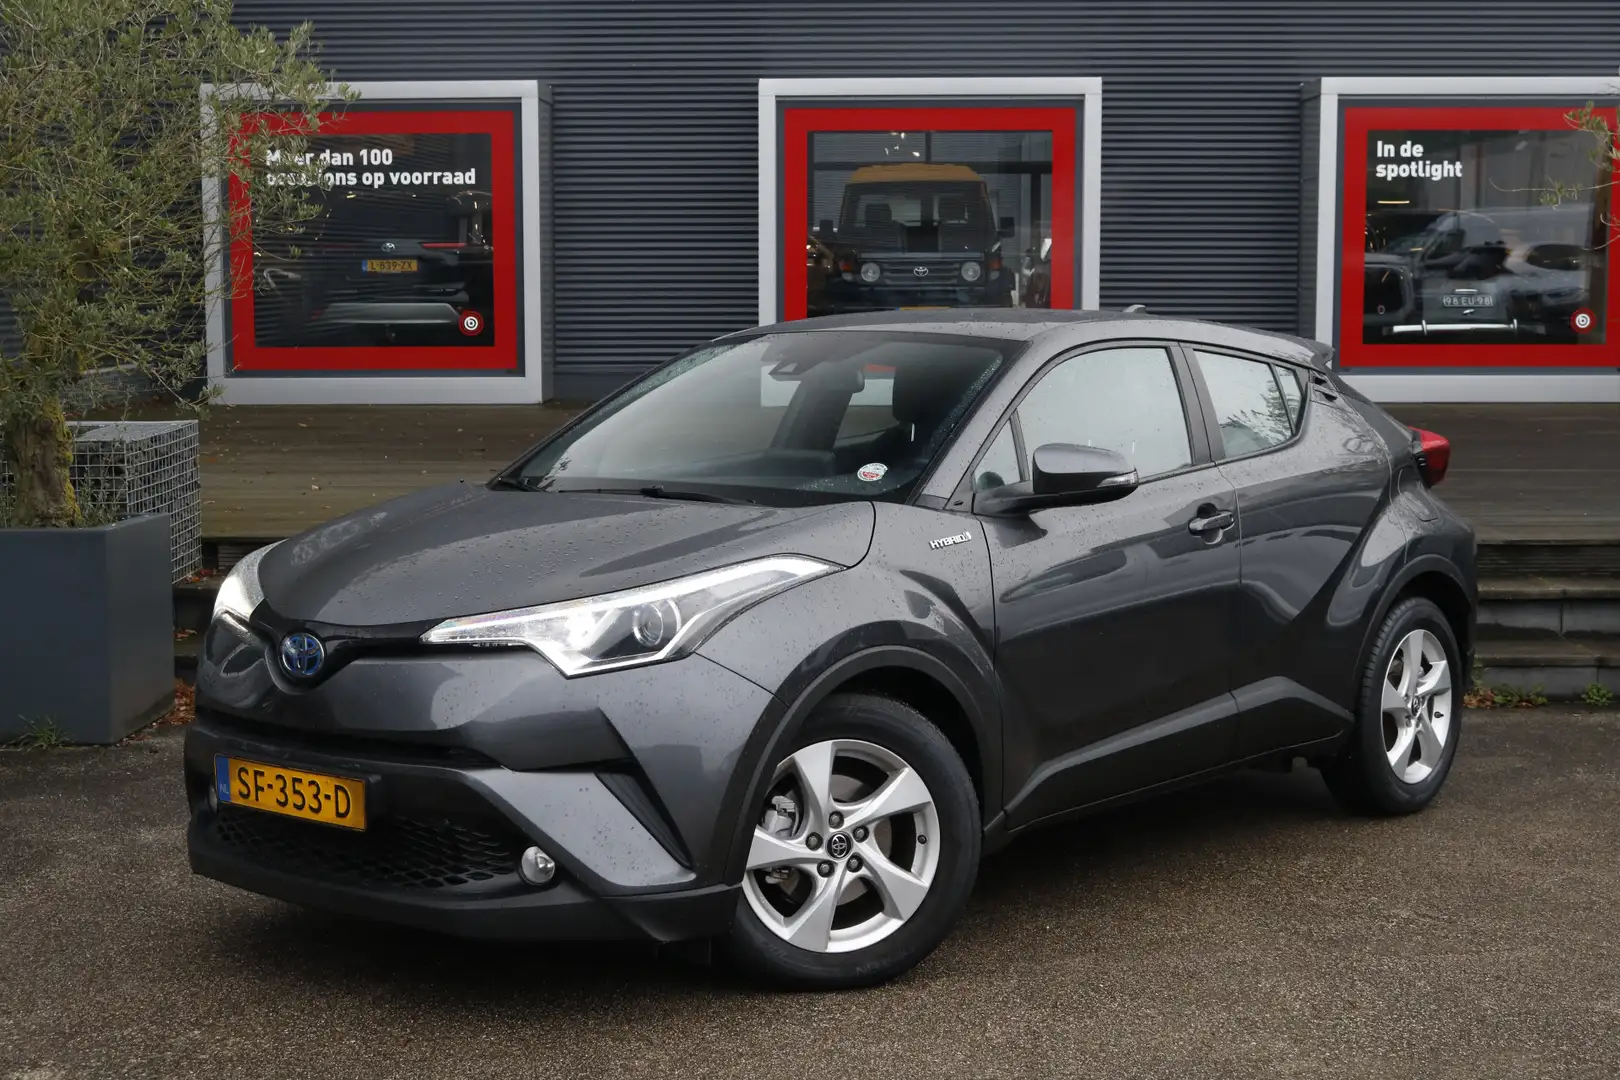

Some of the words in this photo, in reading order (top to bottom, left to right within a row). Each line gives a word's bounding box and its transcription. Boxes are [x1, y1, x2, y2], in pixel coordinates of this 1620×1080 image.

[319, 148, 354, 166] dan
[359, 148, 393, 166] 100
[1376, 140, 1395, 158] In
[1399, 140, 1424, 158] de
[362, 171, 385, 188] op
[389, 168, 476, 186] voorraad
[1375, 160, 1463, 181] spotlight
[929, 534, 967, 549] HYBRID
[219, 783, 229, 794] NL
[236, 766, 351, 818] SF-353-D
